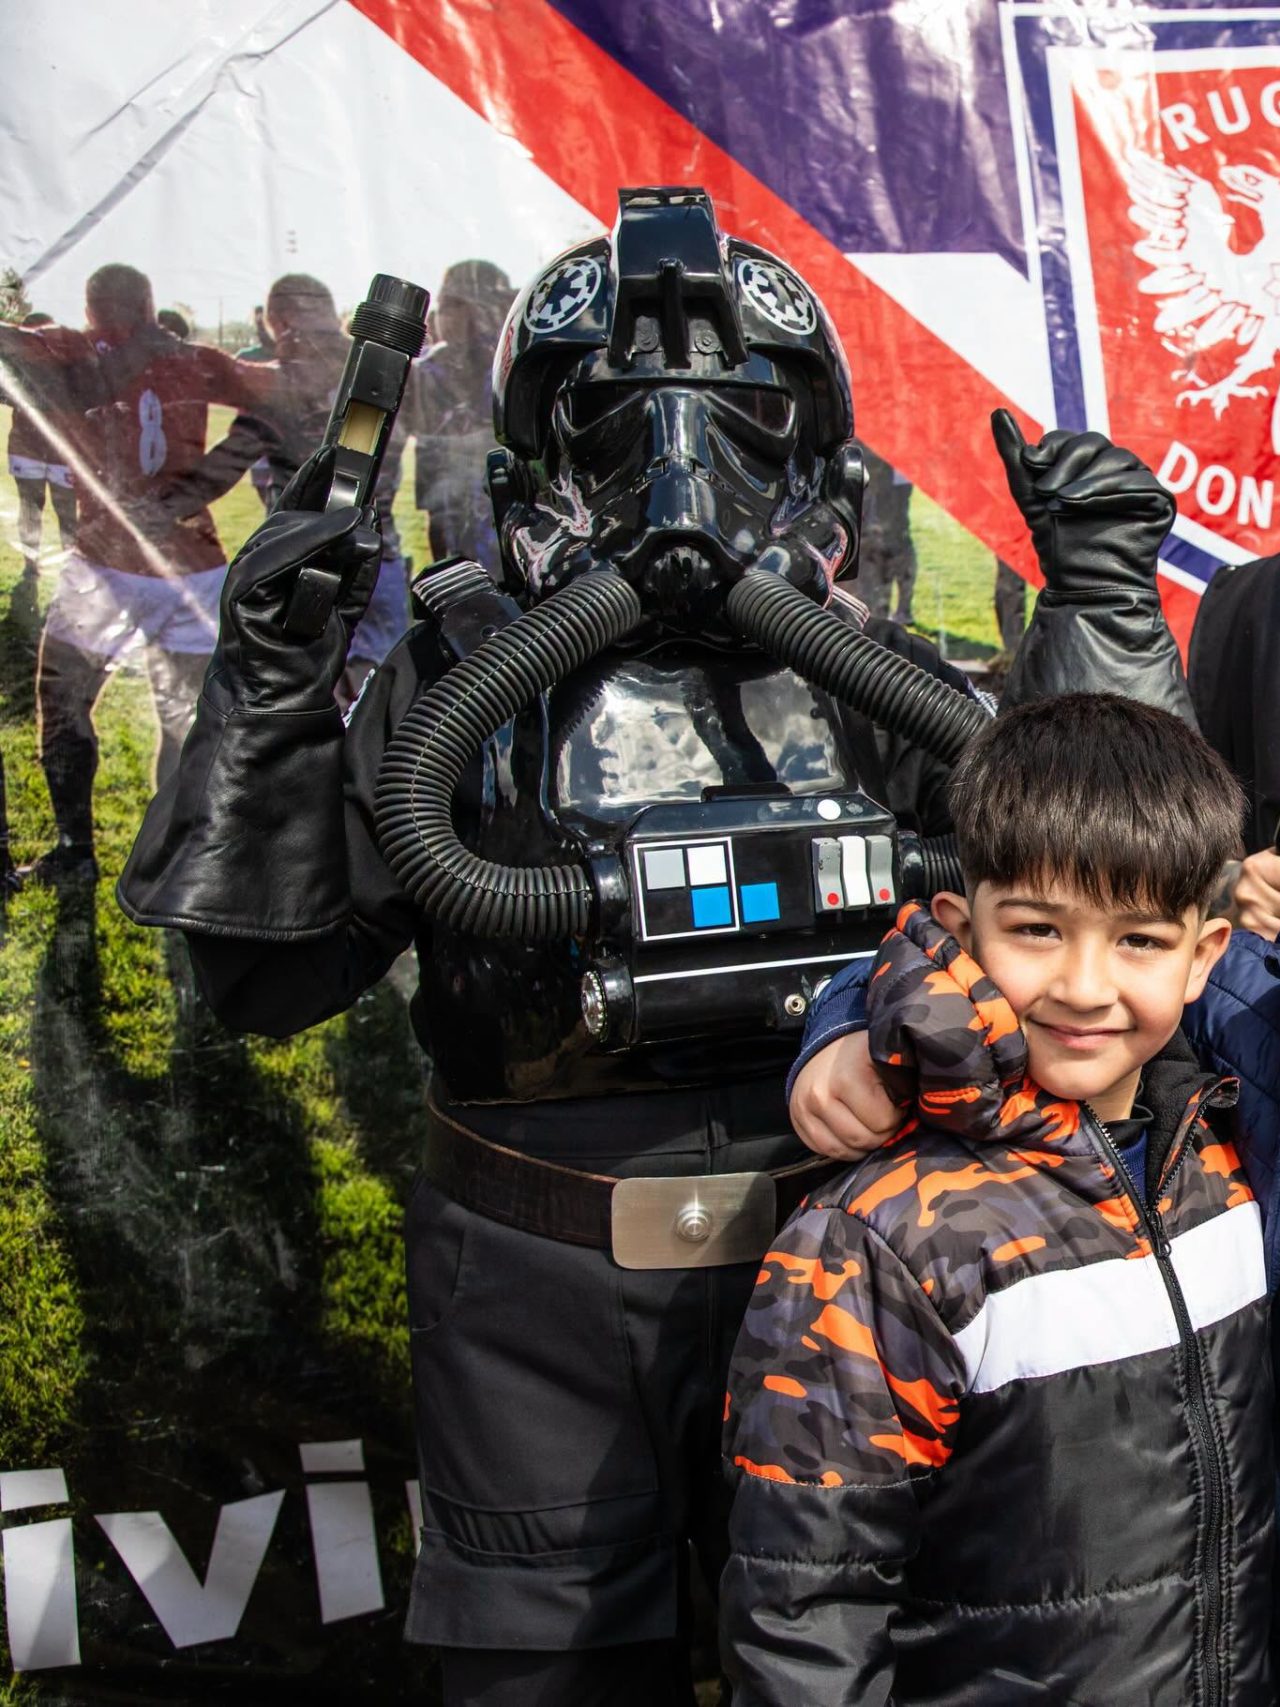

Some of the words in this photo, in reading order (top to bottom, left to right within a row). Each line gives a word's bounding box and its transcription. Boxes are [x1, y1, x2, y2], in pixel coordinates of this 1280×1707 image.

[138, 387, 167, 478] 8
[1156, 440, 1274, 529] DON
[0, 1438, 424, 1673] ivi
